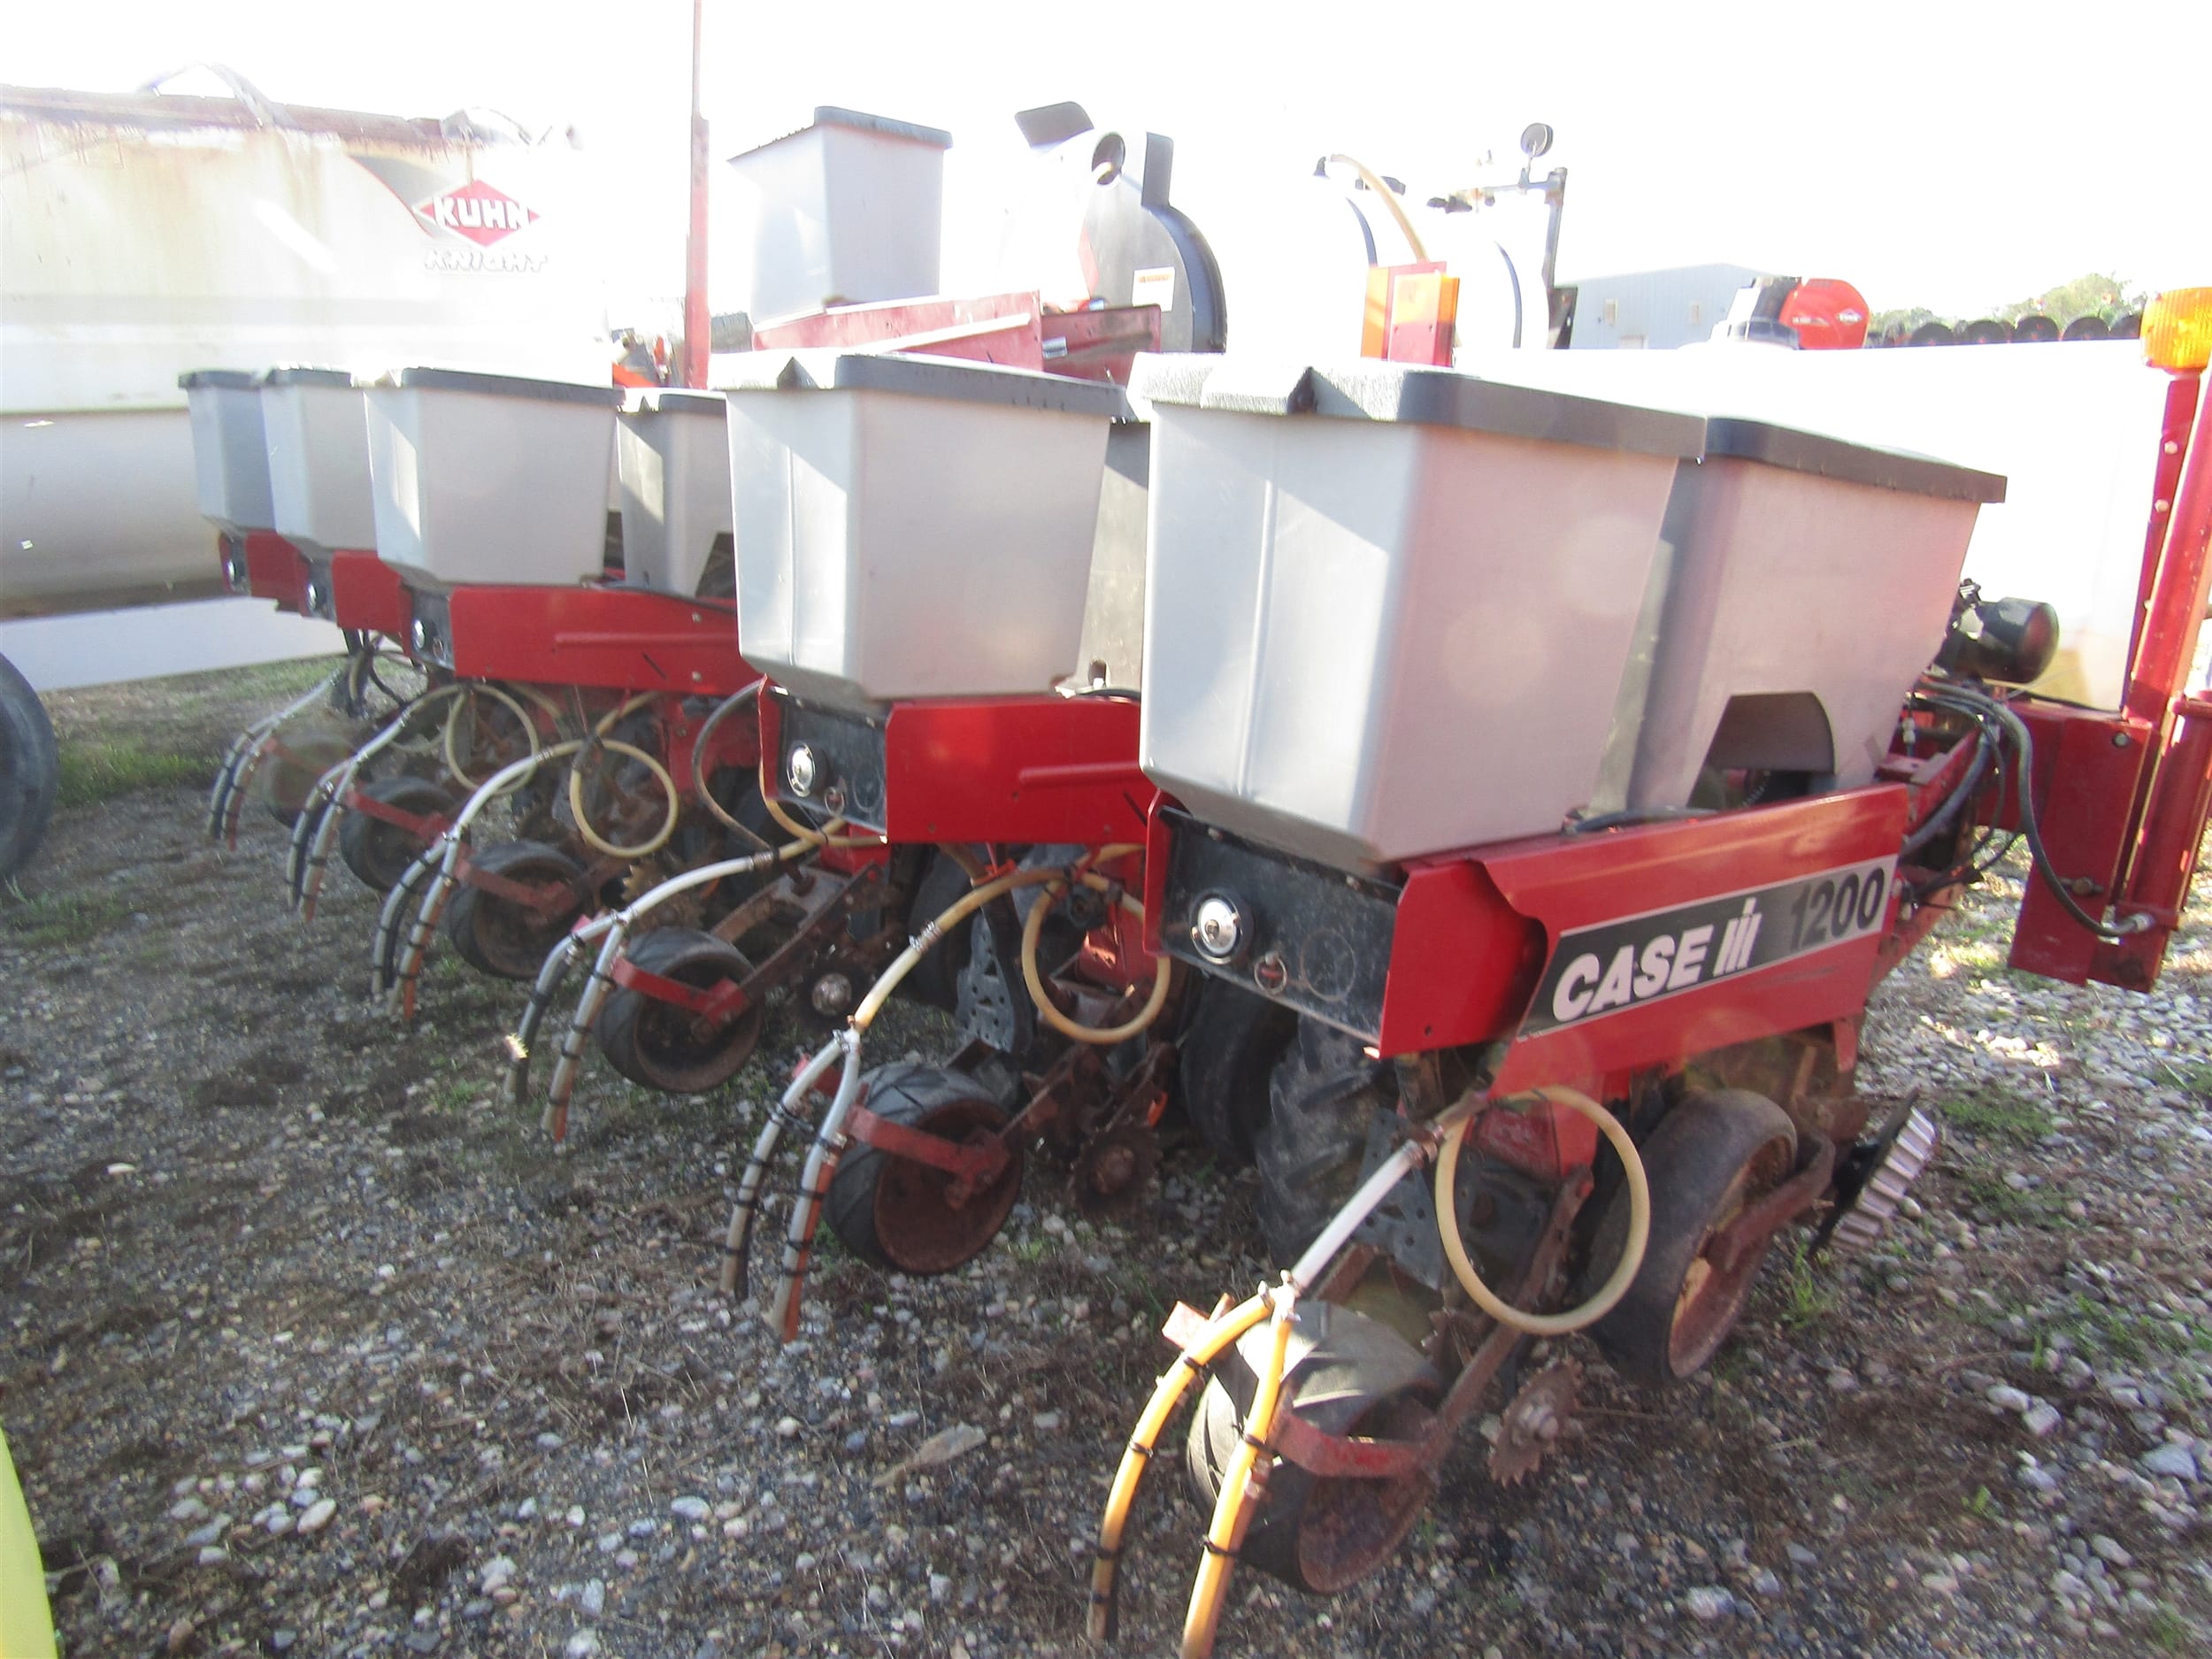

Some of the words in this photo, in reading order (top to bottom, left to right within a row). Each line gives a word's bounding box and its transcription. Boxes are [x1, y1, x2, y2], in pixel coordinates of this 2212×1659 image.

[433, 196, 530, 230] KUHN
[1553, 924, 1714, 1022] CASE
[1789, 867, 1886, 953] 1200
